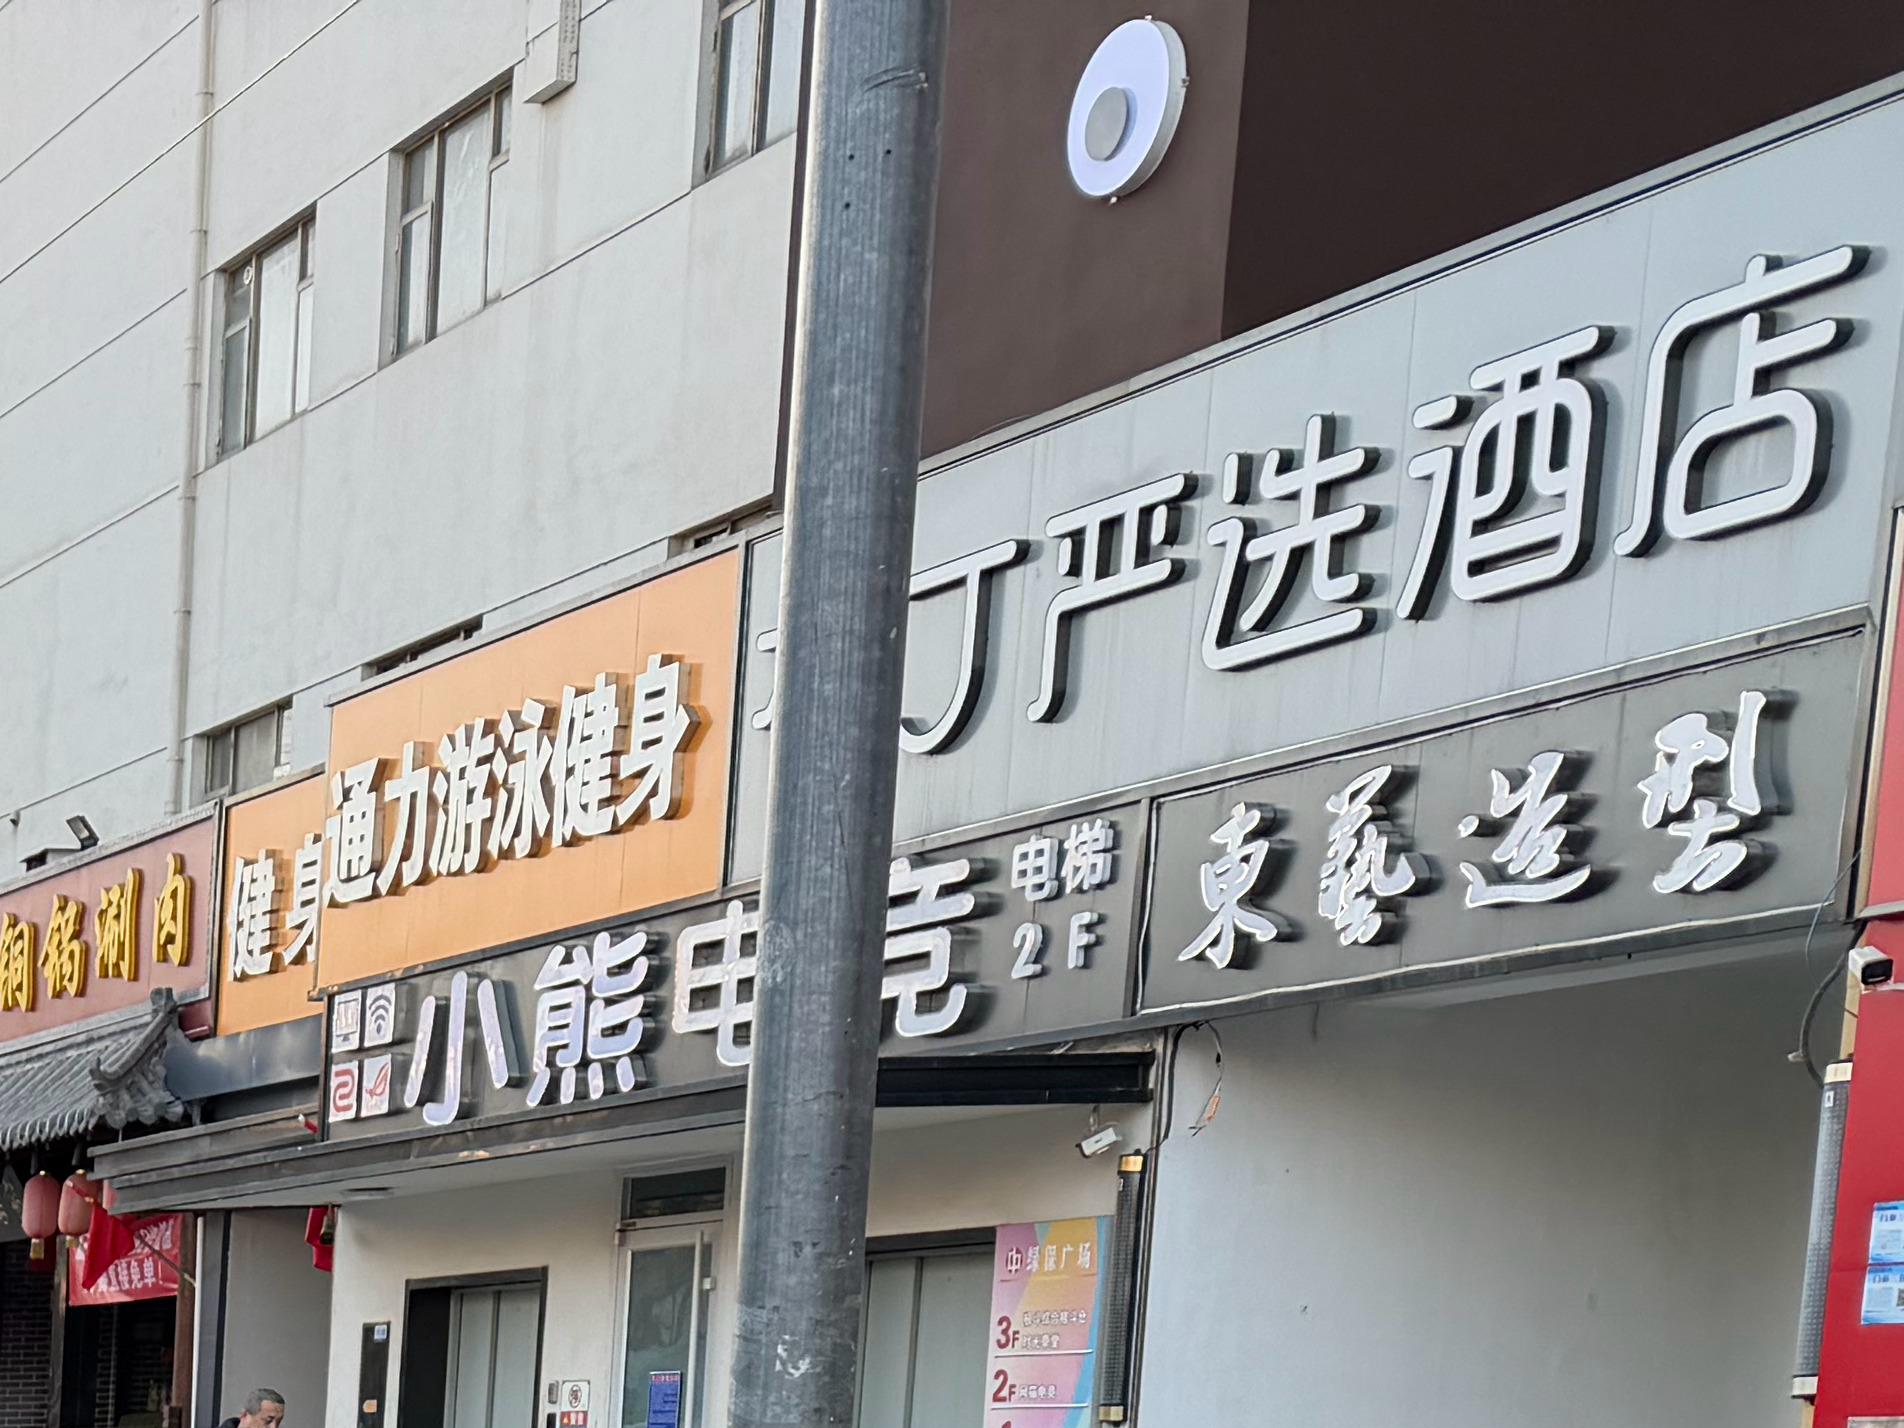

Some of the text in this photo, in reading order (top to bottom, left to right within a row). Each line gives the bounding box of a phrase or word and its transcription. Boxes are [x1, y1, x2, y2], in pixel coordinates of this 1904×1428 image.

[752, 243, 1870, 755] 丁严选酒店
[324, 653, 694, 908] 通力游泳健身
[1011, 817, 1114, 902] 电梯
[228, 831, 321, 983] 健身
[1011, 910, 1104, 980] 2F
[996, 1314, 1020, 1351] 3F
[992, 1368, 1016, 1403] 2F
